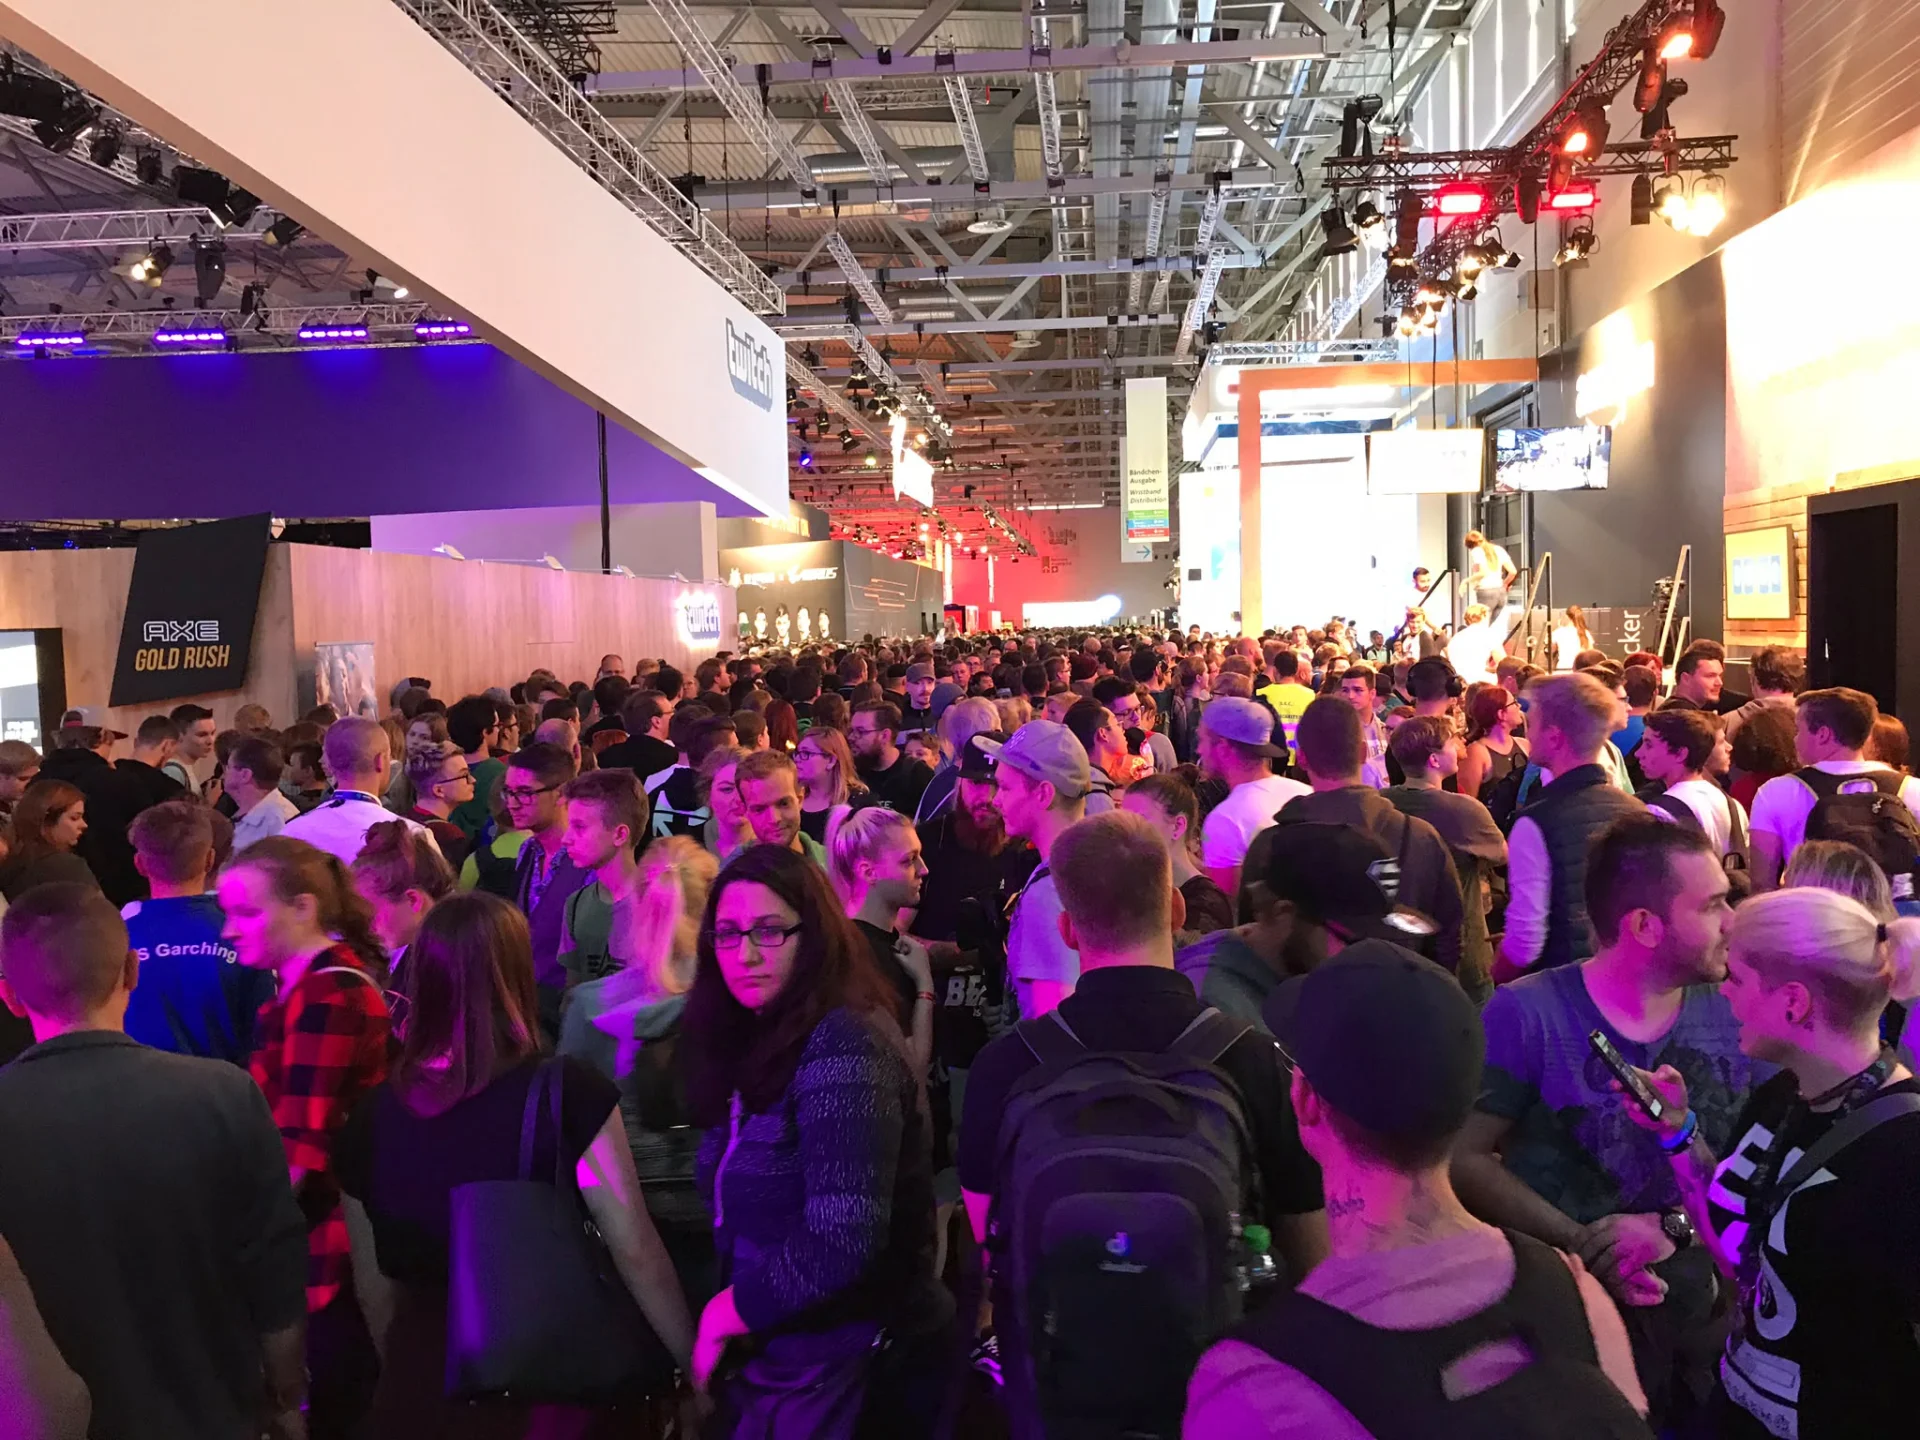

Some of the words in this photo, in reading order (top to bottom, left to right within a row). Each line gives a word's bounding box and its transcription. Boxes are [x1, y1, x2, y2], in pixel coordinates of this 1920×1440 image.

[726, 317, 773, 412] twitch
[143, 620, 219, 641] AXE
[135, 647, 180, 671] GOLD
[183, 644, 230, 669] RUSH
[155, 941, 237, 964] Garching
